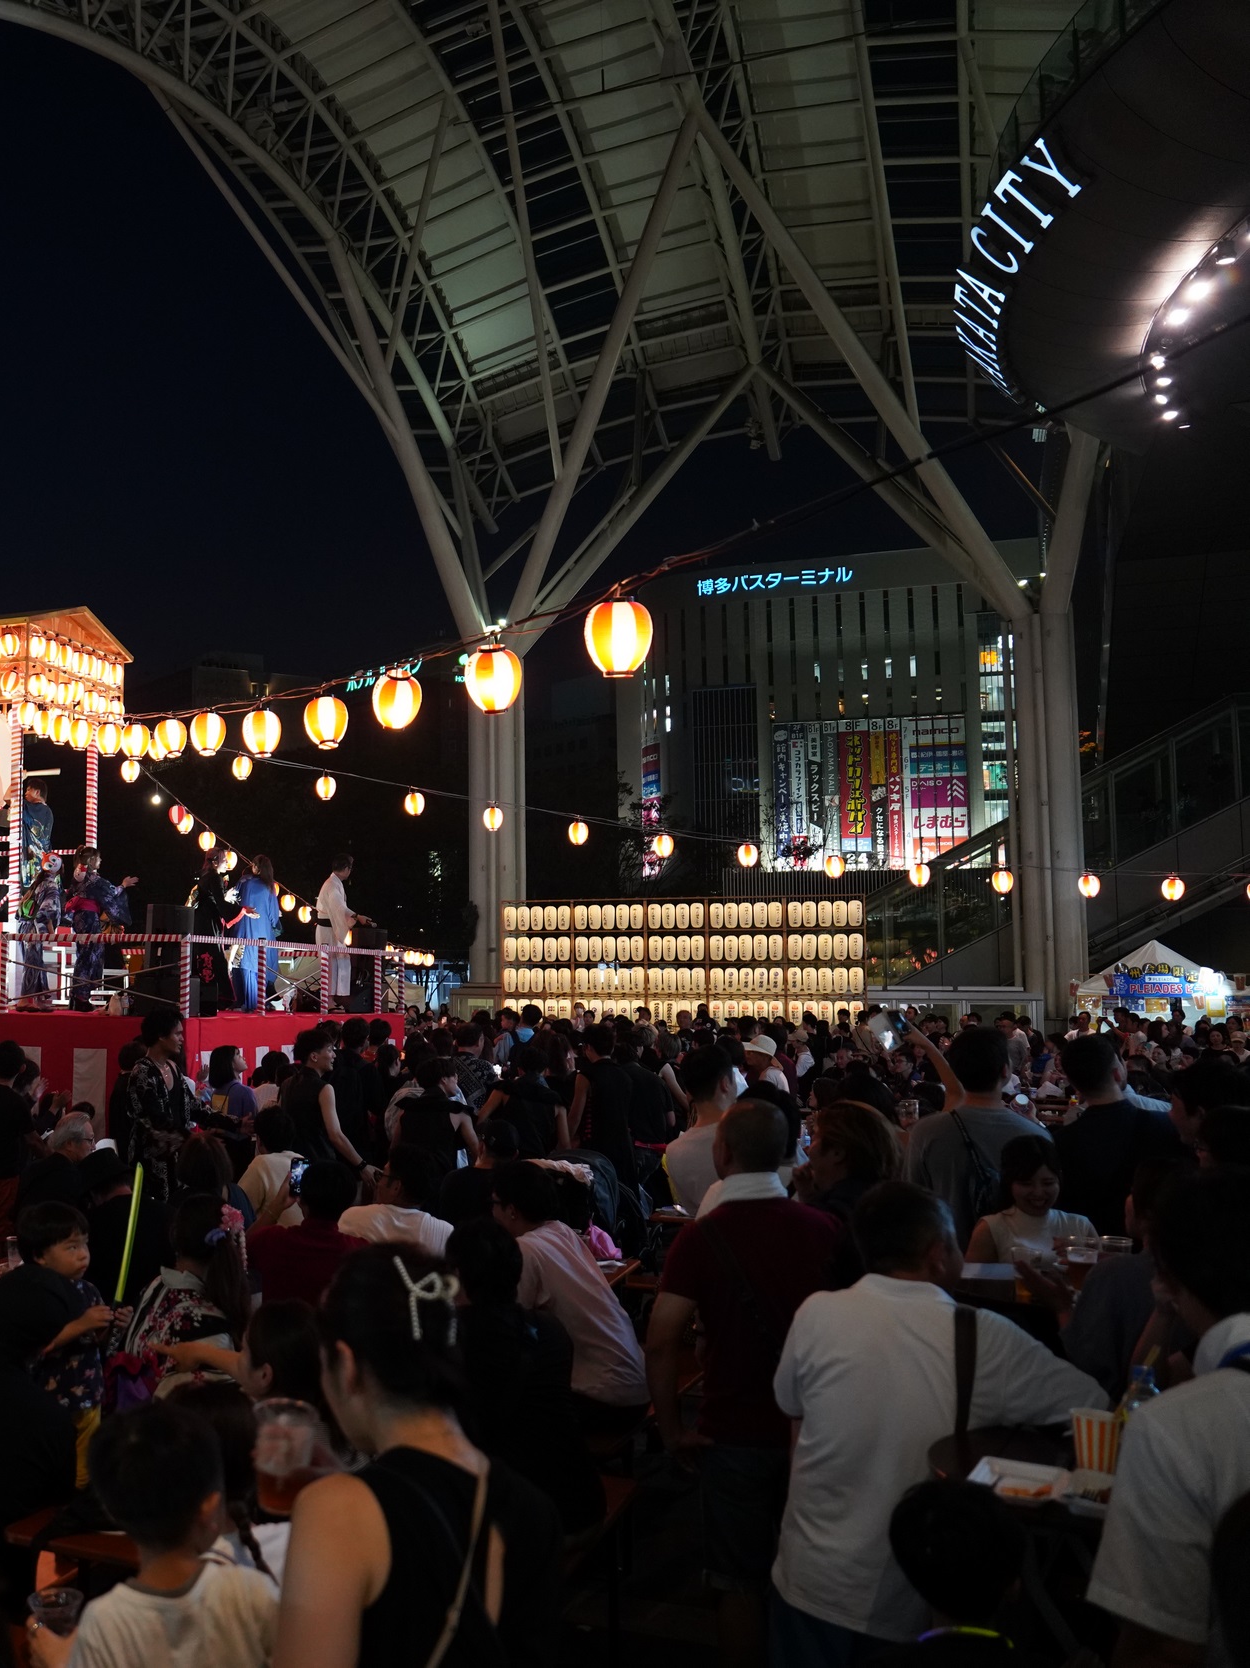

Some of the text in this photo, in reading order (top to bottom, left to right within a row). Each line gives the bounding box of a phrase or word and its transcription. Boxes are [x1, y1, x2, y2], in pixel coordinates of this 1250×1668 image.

[953, 137, 1082, 405] AKATA CITY
[697, 566, 853, 596] 博多バスターミナル
[912, 727, 959, 736] namco
[911, 779, 943, 787] DAISO
[810, 764, 821, 822] ラックスビー
[913, 813, 967, 829] しまむら
[1130, 984, 1183, 994] PLEIADES
